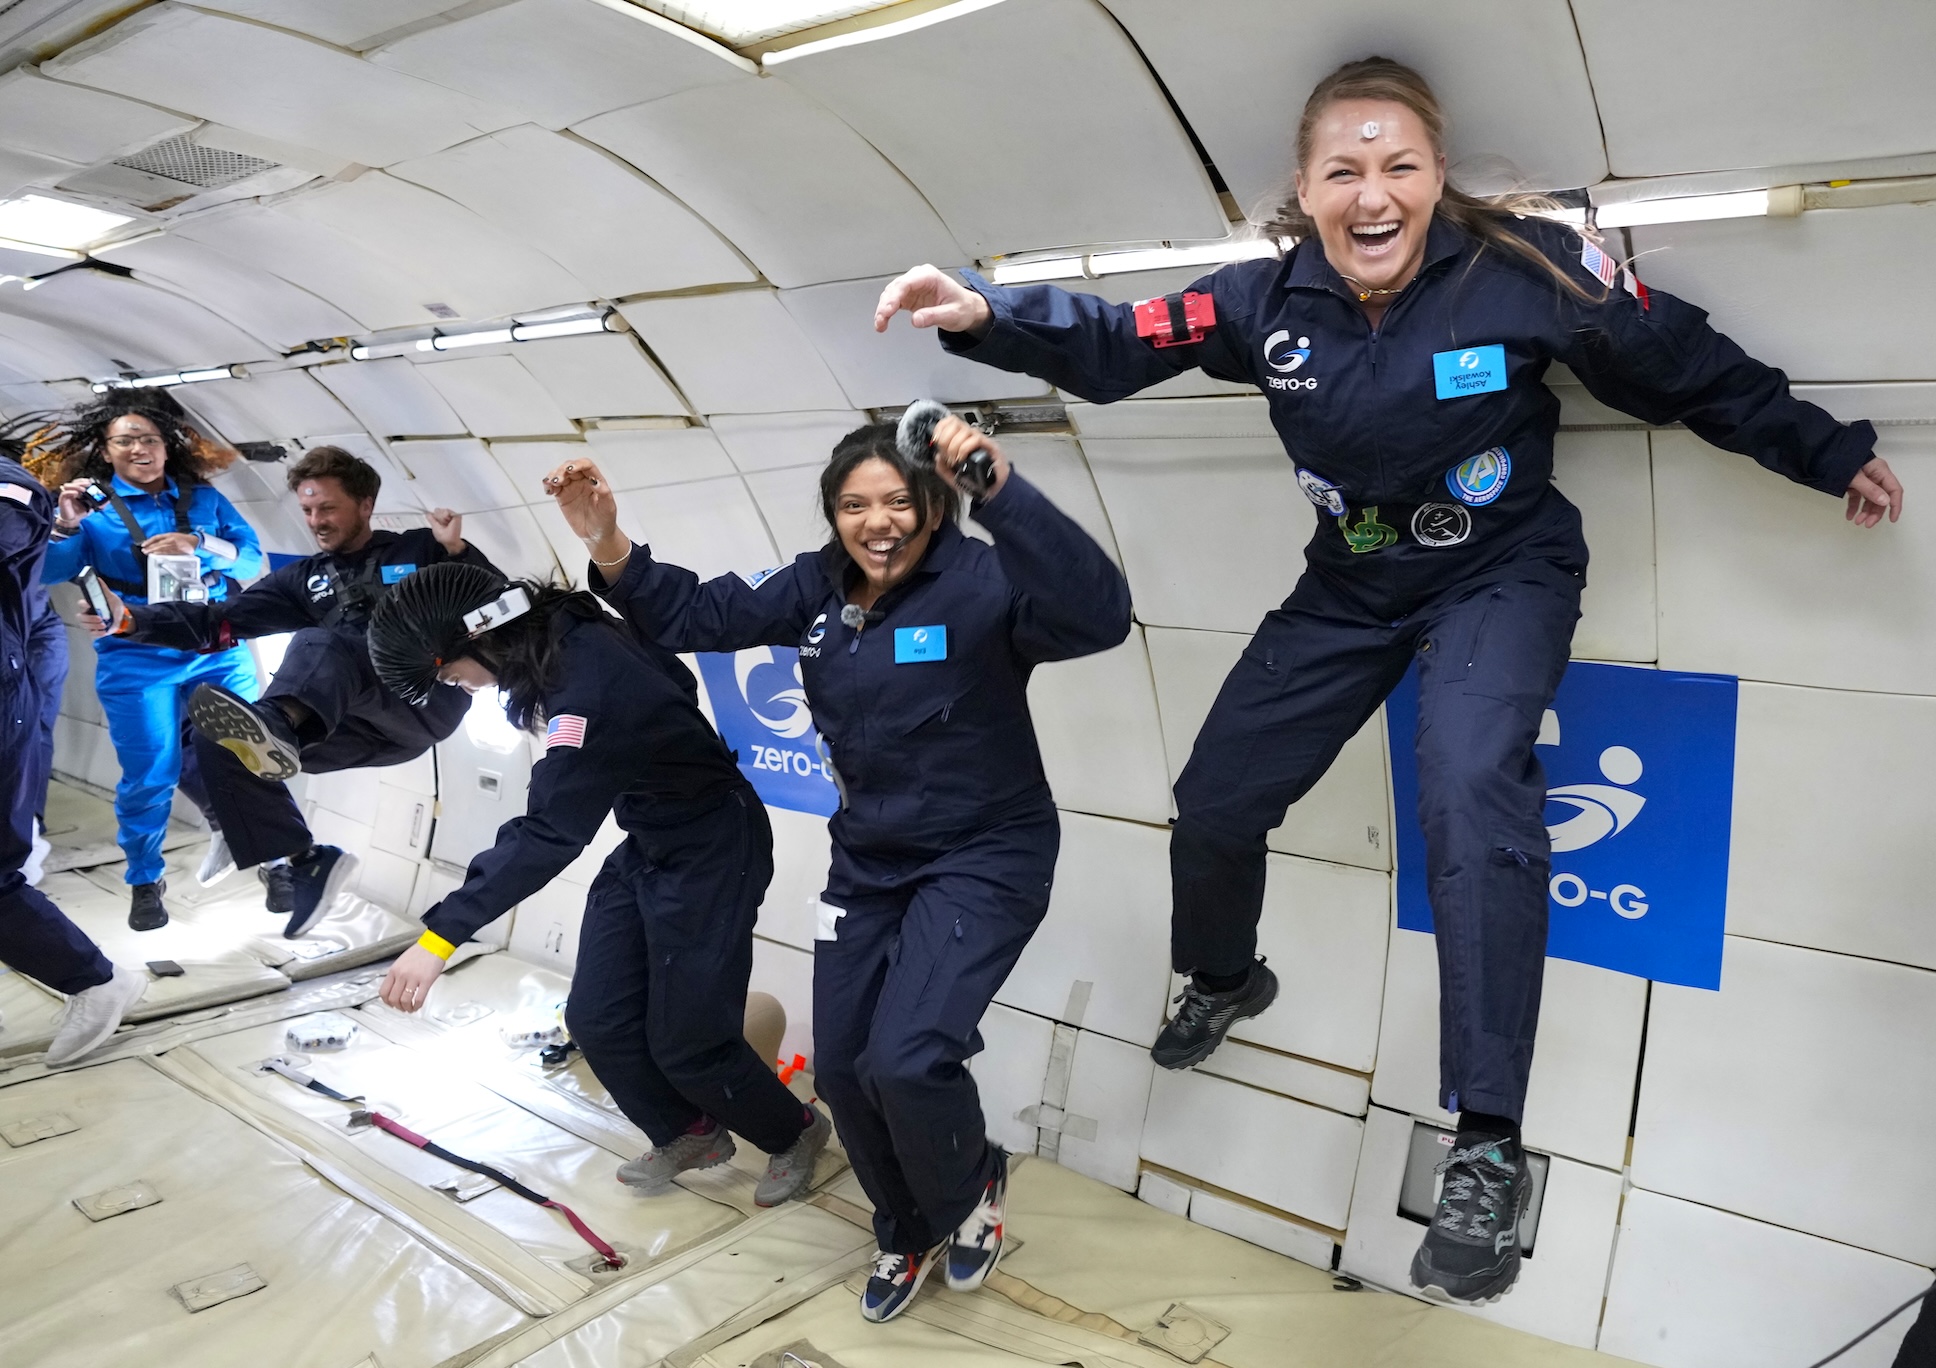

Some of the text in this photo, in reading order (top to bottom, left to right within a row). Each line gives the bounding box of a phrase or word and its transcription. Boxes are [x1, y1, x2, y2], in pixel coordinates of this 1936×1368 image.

[1265, 376, 1318, 391] zero-G
[1449, 370, 1492, 385] Kowalski
[1455, 379, 1487, 390] Ashley
[1461, 493, 1475, 503] THE
[1473, 480, 1504, 503] AEROSPACE
